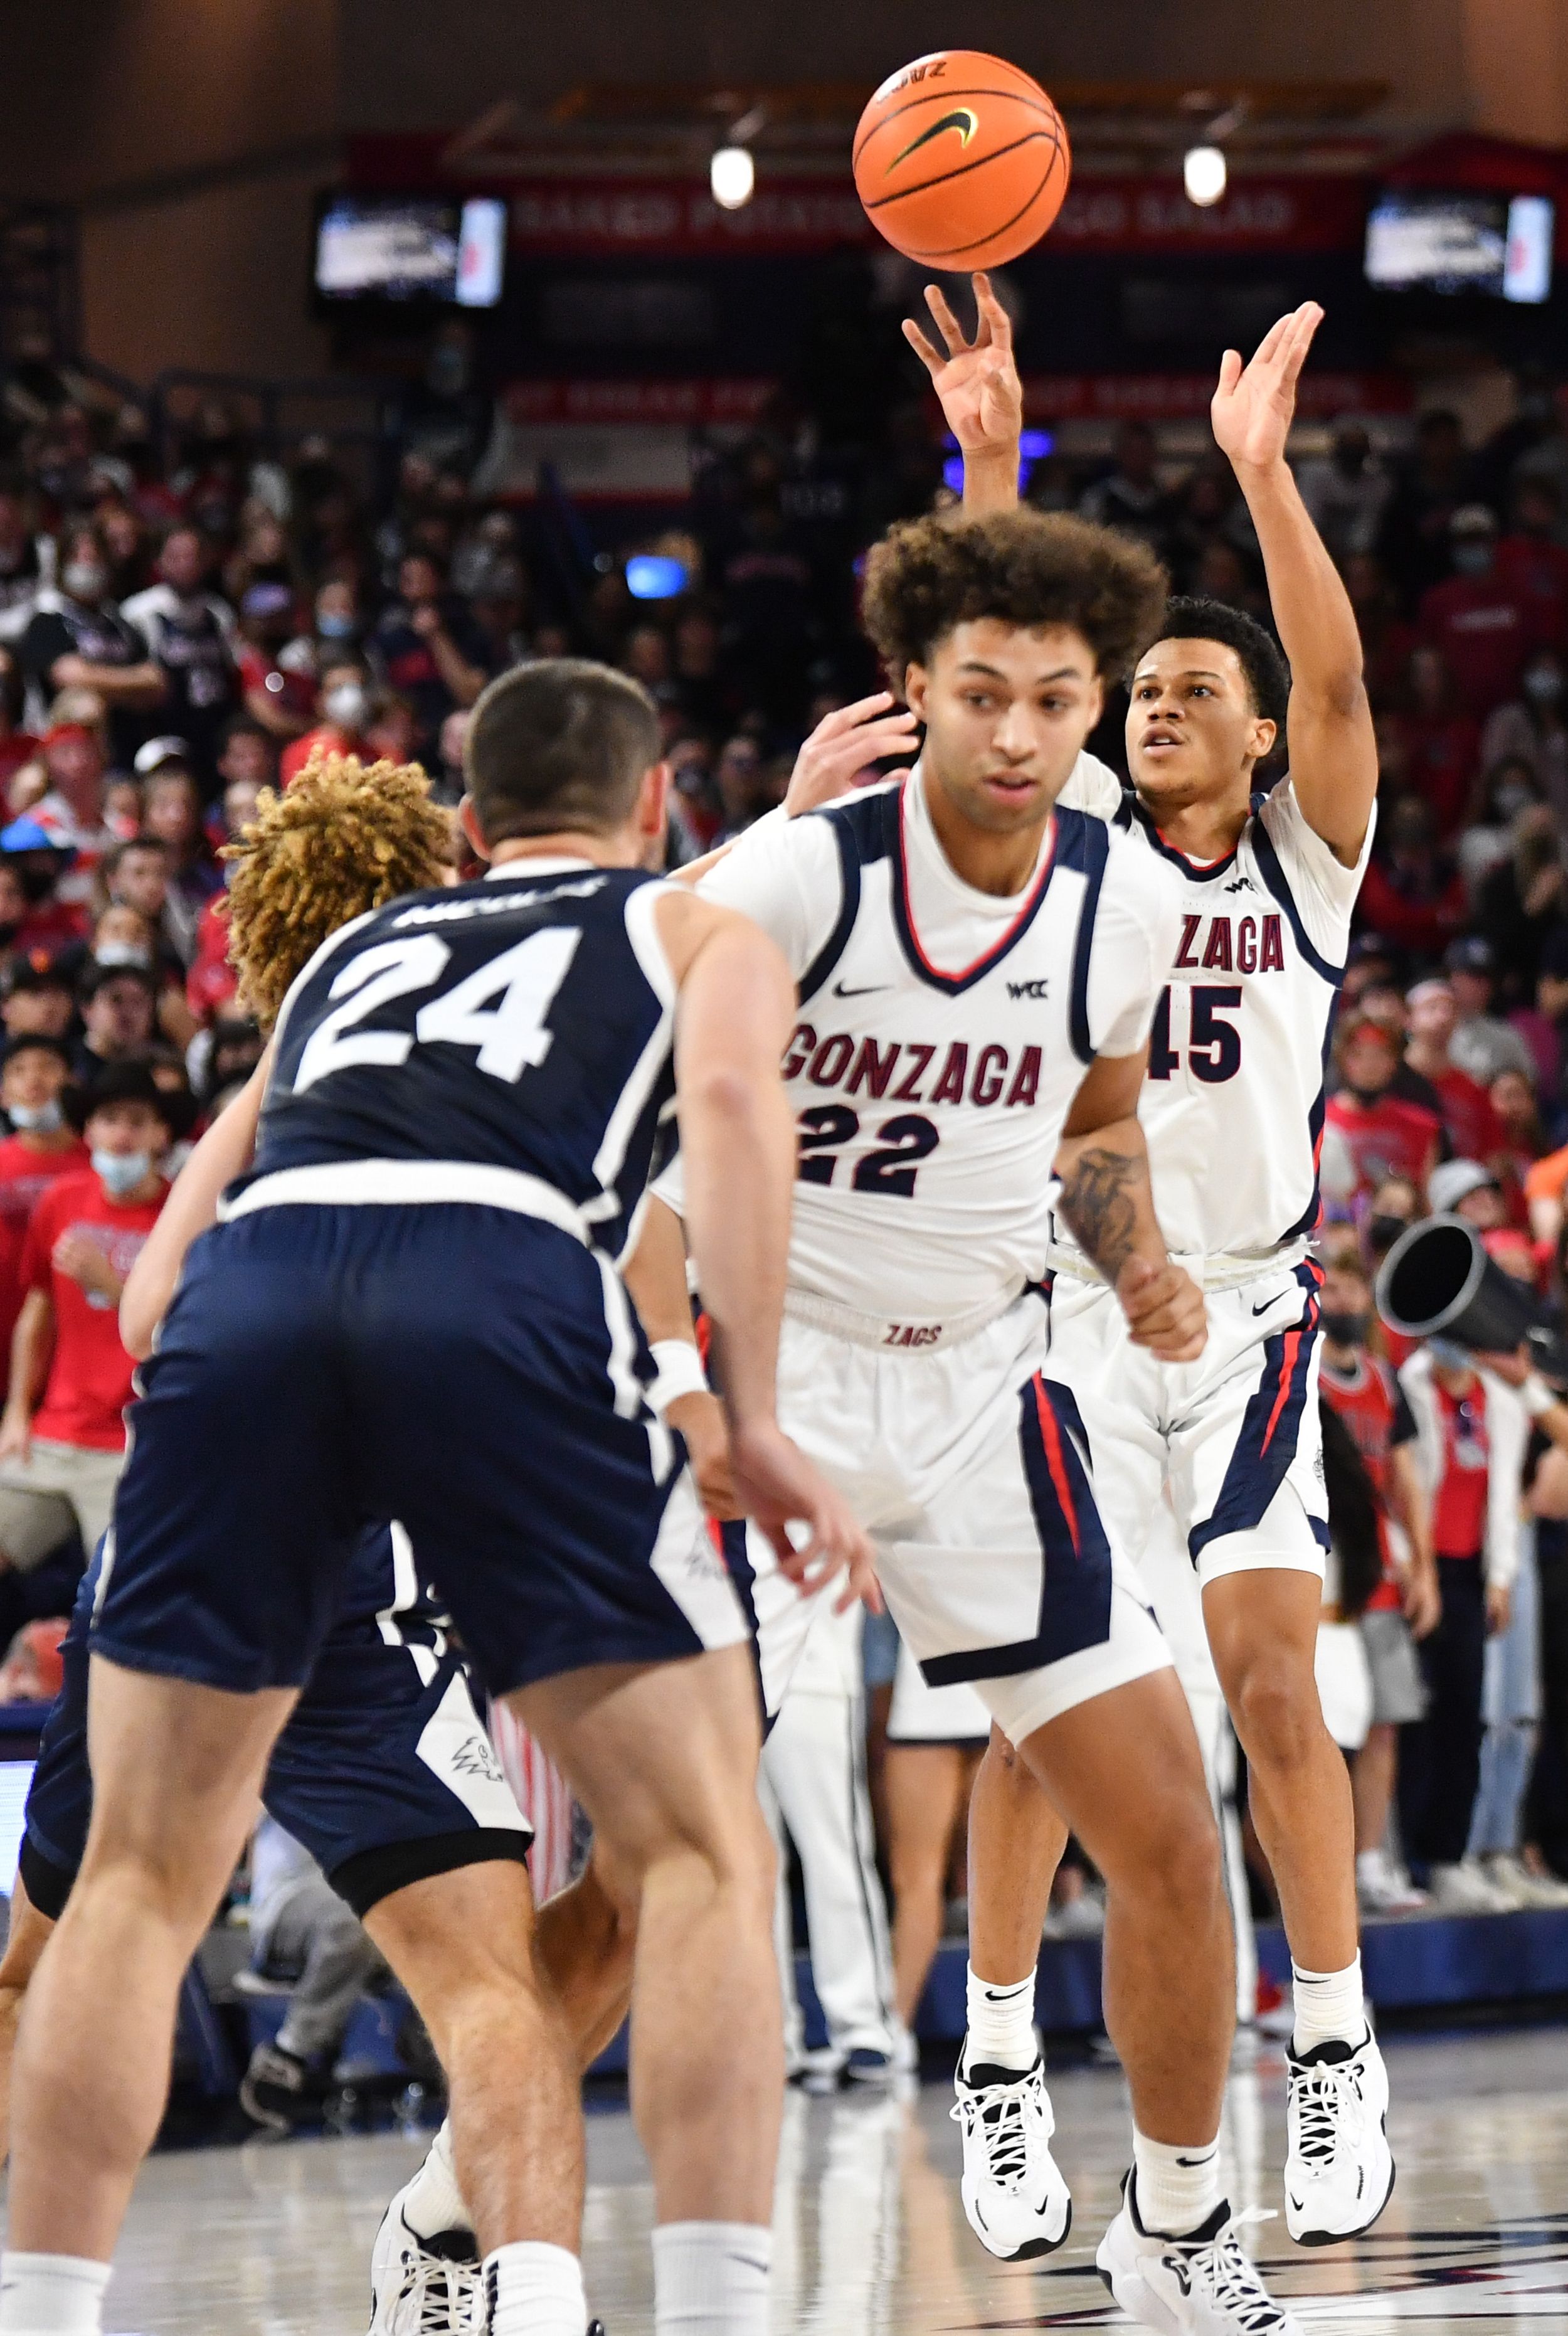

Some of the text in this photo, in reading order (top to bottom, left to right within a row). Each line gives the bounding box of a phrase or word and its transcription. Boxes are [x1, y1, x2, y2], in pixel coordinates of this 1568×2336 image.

[1172, 913, 1285, 975] ZAGA
[292, 925, 583, 1095] 24
[781, 1022, 1042, 1108] GONZAGA
[797, 1104, 940, 1198] 22
[882, 1324, 942, 1347] ZAGS
